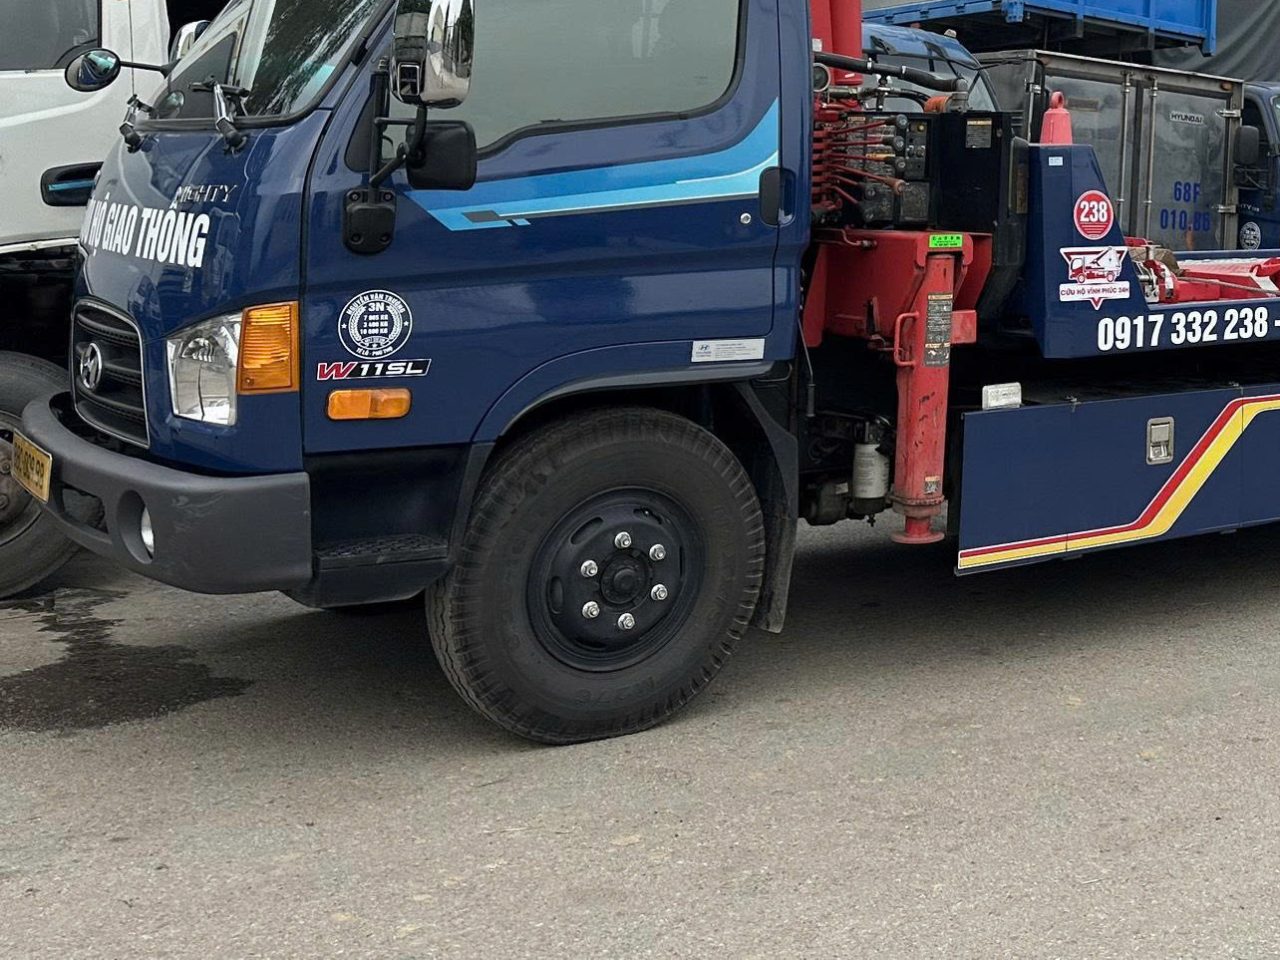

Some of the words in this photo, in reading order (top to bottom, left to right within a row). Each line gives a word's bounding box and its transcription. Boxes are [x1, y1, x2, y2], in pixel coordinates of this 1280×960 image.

[1171, 113, 1202, 123] HYUNDAI
[1080, 200, 1108, 223] 238
[102, 202, 139, 255] GIAO
[135, 199, 211, 268] THÔNG
[368, 302, 385, 312] 3N
[1097, 313, 1165, 352] 0917
[1170, 309, 1219, 345] 332
[1223, 306, 1269, 341] 238
